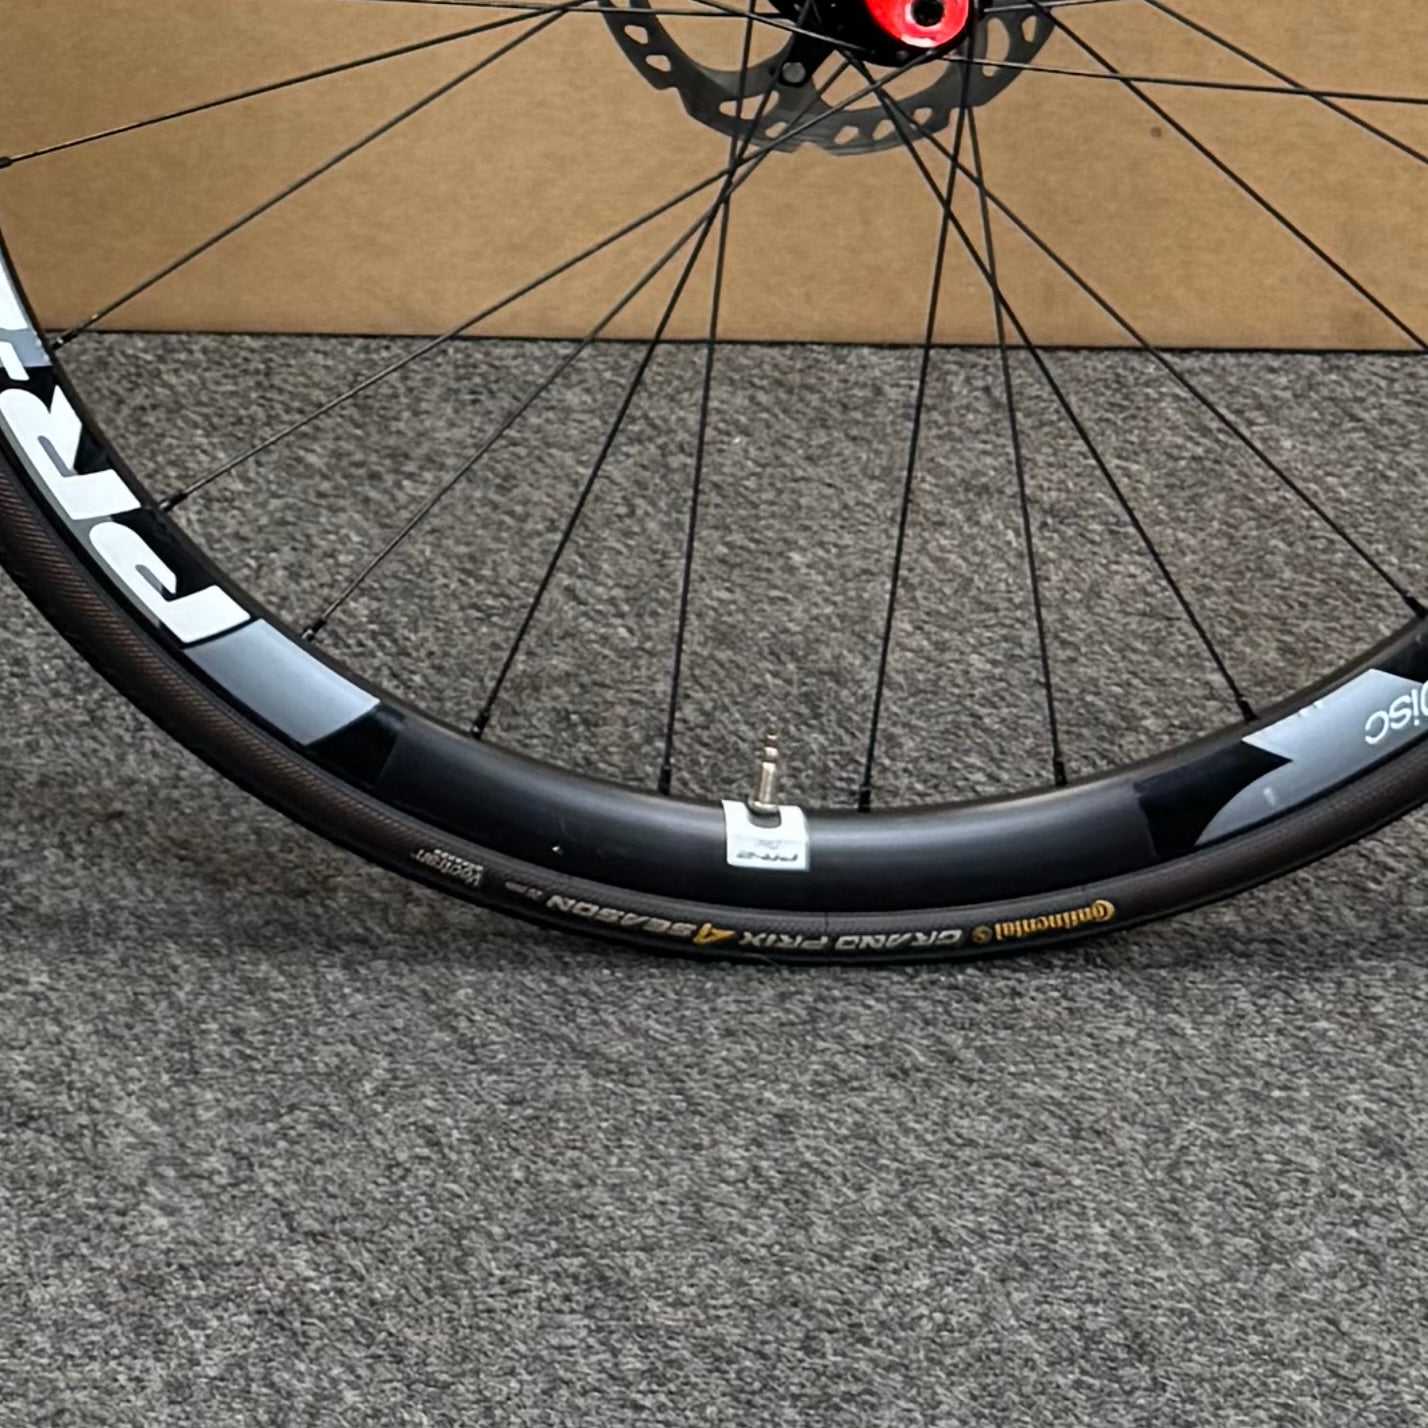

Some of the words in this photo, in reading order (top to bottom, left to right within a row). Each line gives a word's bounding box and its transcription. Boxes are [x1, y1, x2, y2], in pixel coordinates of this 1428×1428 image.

[995, 899, 1115, 941] Continental
[741, 930, 829, 950] PRIX
[835, 929, 962, 950] GRAND
